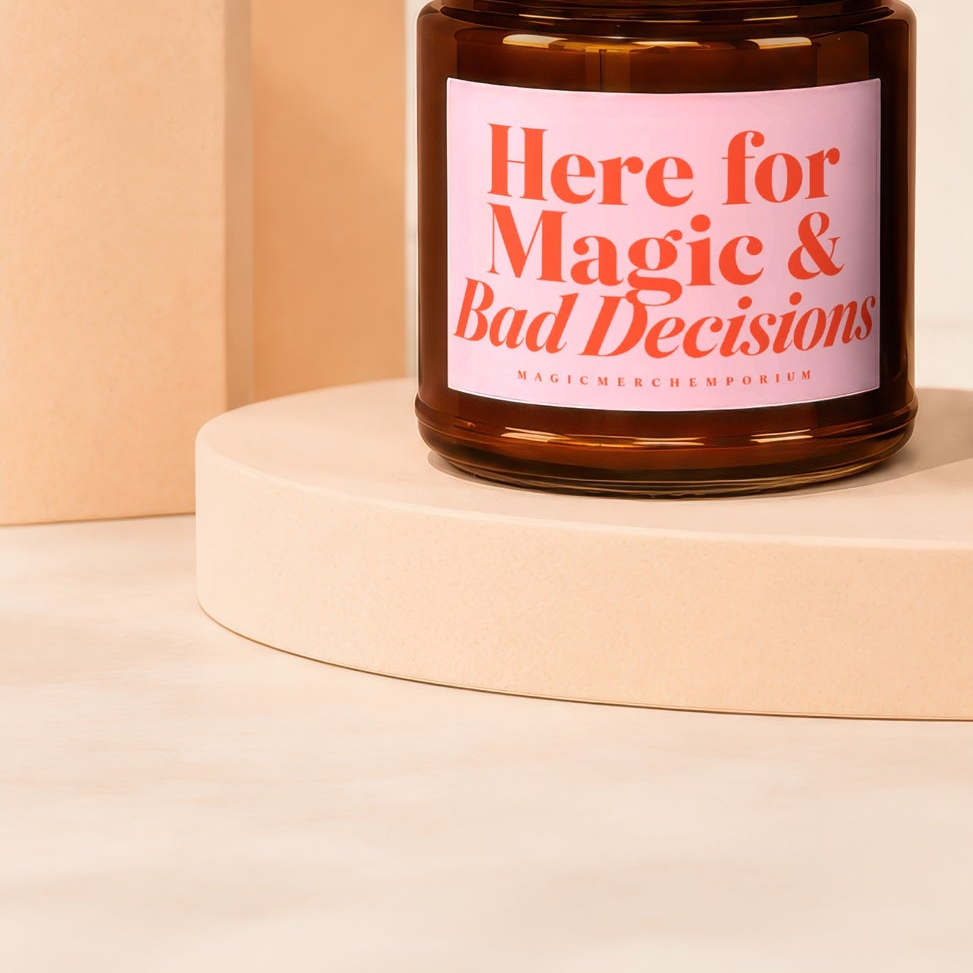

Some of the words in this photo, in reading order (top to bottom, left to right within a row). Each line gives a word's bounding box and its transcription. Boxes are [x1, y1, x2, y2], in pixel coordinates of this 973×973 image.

[487, 123, 694, 207] Here
[721, 129, 842, 206] for
[487, 202, 765, 307] Magic
[787, 211, 845, 281] &
[453, 277, 580, 354] Bad
[578, 291, 877, 359] Decisions
[516, 370, 813, 388] MAGICMERCHEMPORIUM
